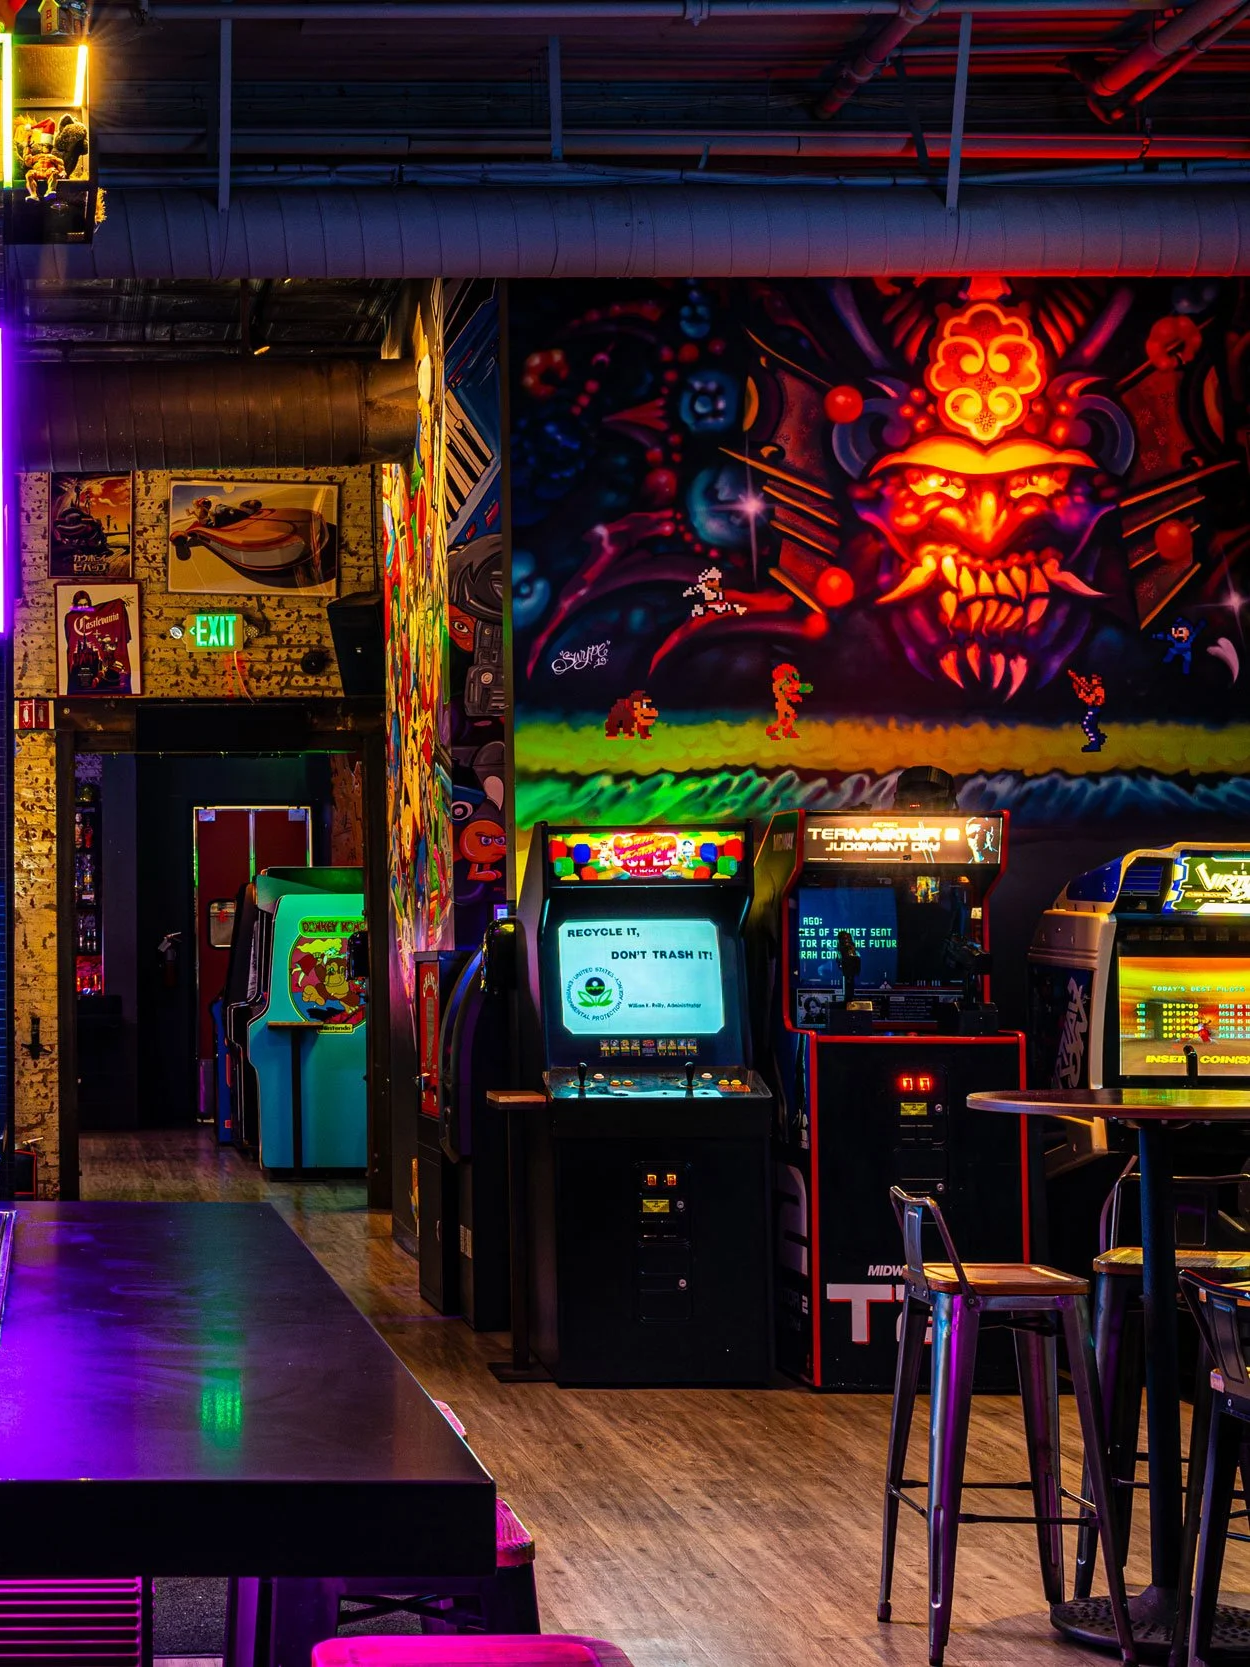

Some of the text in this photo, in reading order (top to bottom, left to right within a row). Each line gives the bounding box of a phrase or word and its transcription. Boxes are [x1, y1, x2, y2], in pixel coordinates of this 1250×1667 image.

[73, 612, 120, 636] Castlevania
[195, 615, 238, 647] EXIT
[807, 827, 942, 841] TERMINATOR
[825, 842, 941, 852] JUDGMENT DAY
[301, 920, 338, 933] DONKEY
[802, 916, 824, 926] AGO:
[567, 927, 641, 938] RECYCLE IT,
[818, 928, 830, 936] OF
[870, 928, 893, 936] SENT
[800, 939, 817, 948] TOR
[869, 938, 898, 948] FUTUR
[611, 950, 713, 960] DON'T TRASH IT!
[573, 966, 615, 980] UNITED STATES
[591, 1000, 623, 1022] PROTECTION
[1145, 1054, 1187, 1064] INSER
